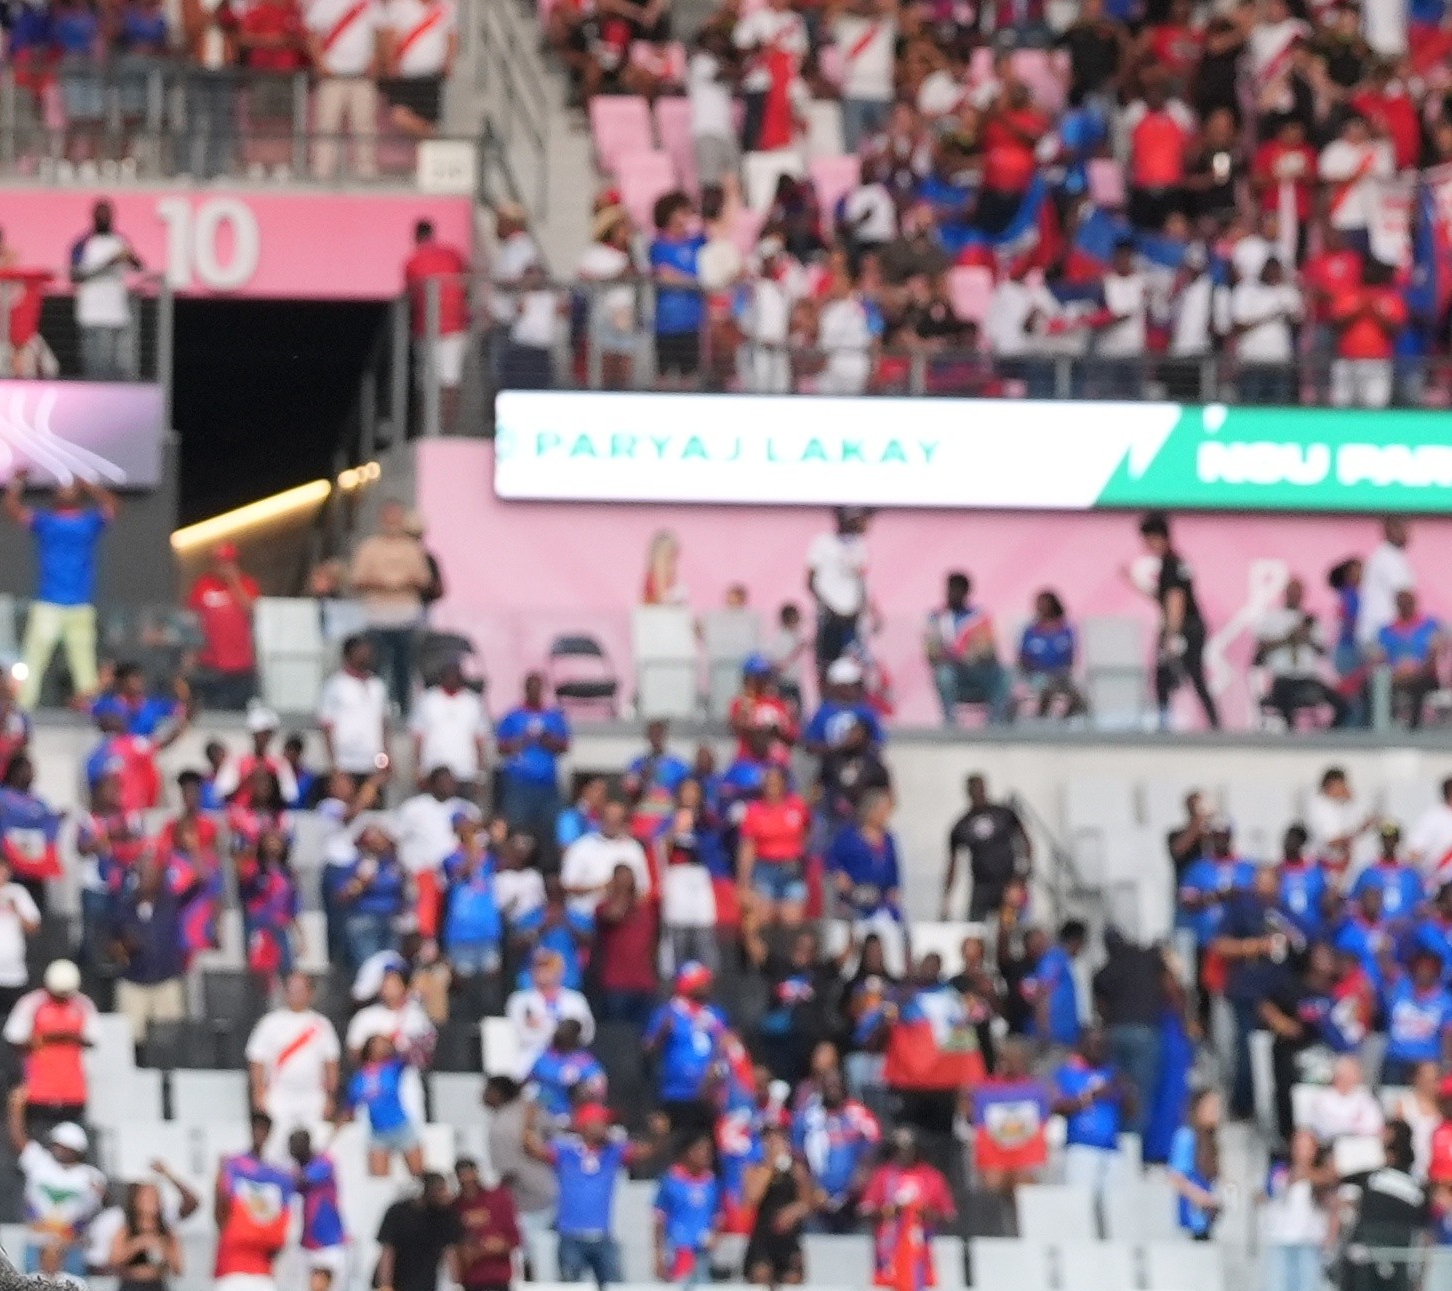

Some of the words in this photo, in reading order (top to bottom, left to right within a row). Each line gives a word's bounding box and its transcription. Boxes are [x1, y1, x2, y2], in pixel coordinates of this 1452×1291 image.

[157, 196, 260, 290] 10
[536, 432, 742, 461] PARYAJ
[766, 437, 941, 463] LAKAY
